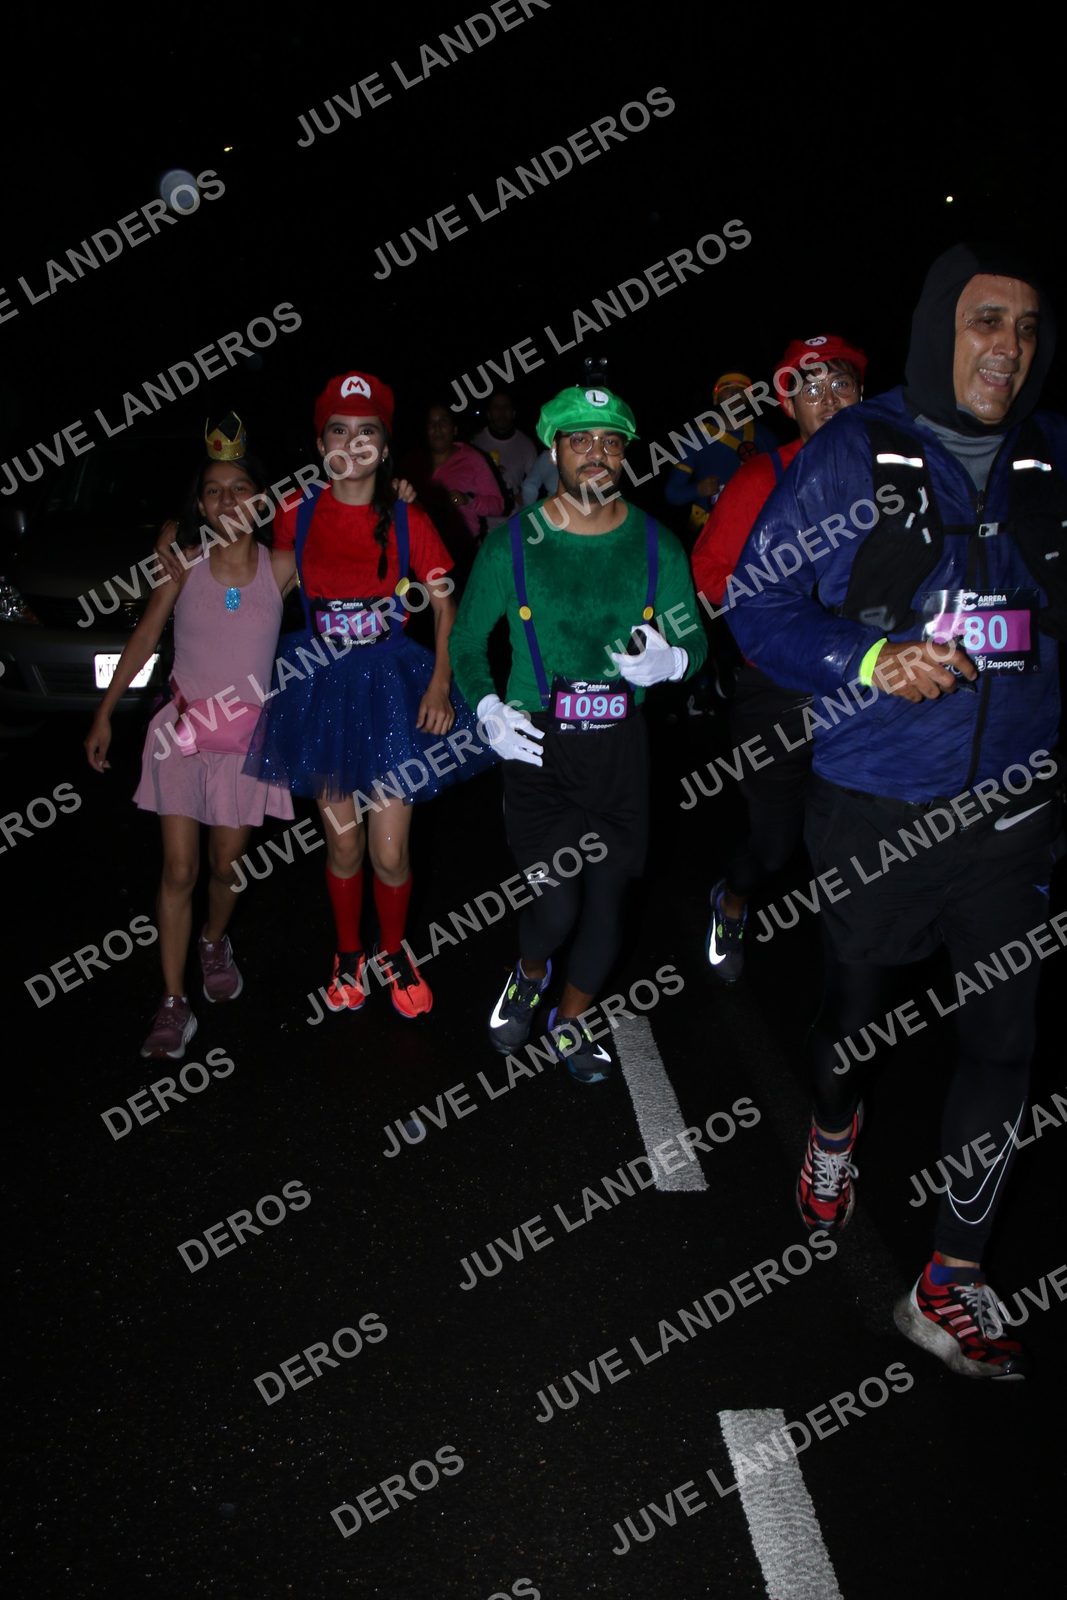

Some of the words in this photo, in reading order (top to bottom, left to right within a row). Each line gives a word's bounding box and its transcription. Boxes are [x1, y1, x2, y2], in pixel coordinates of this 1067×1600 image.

[347, 381, 365, 391] M
[593, 392, 605, 403] L
[320, 613, 376, 634] 1311
[963, 615, 1008, 650] 80
[560, 695, 625, 717] 1096
